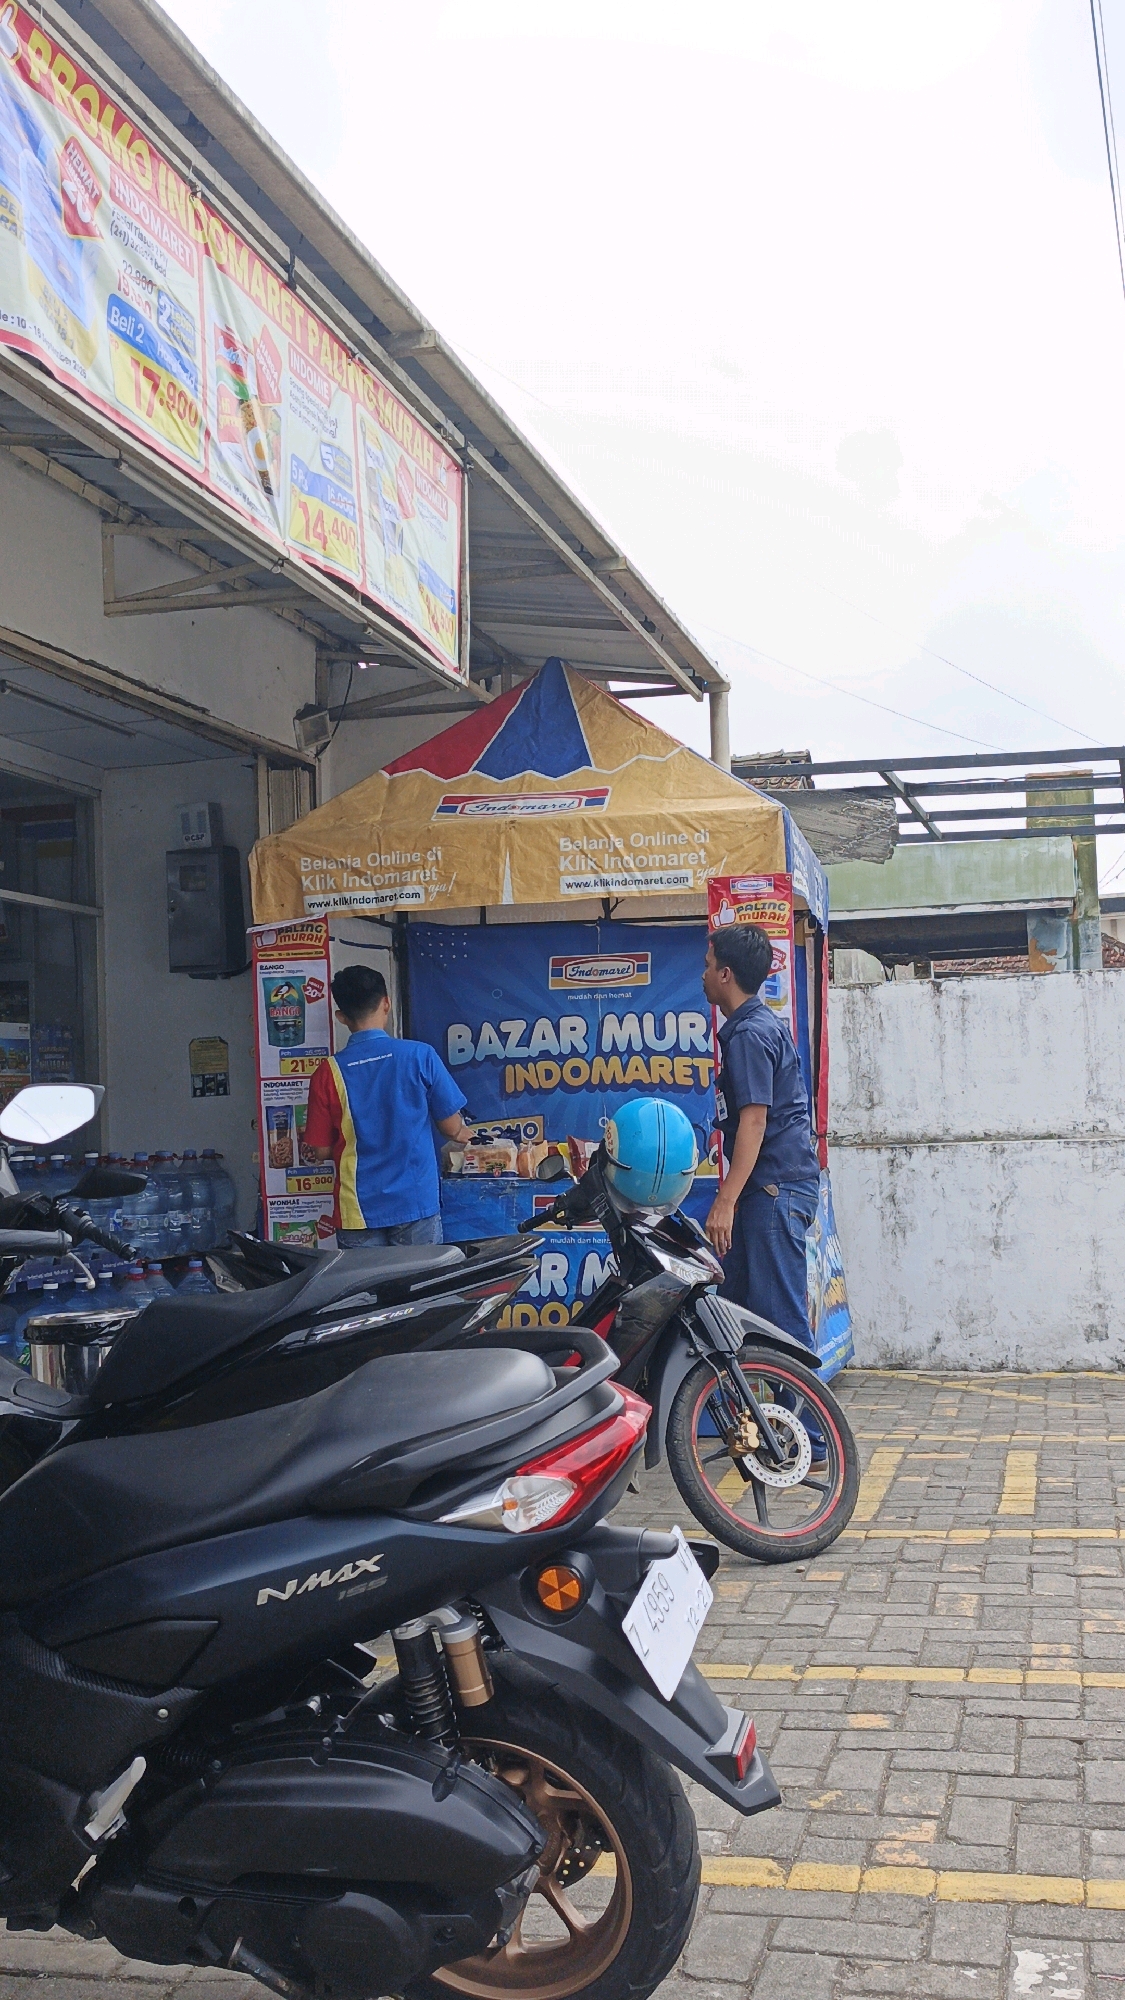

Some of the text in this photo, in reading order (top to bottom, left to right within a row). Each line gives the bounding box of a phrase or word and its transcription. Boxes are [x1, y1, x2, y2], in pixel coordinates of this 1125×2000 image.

[66, 143, 100, 198] HEMAT
[115, 175, 191, 269] INDOMARET
[27, 28, 154, 191] PROMO
[157, 160, 307, 345] INDOMARET
[307, 316, 377, 411] PALING
[377, 385, 434, 477] MURAH
[17, 316, 27, 329] 10
[109, 306, 145, 344] Beli 2
[290, 348, 330, 401] INDOMIE
[130, 356, 199, 428] 17.900
[298, 499, 356, 550] 14.400
[472, 798, 577, 813] Indomaret
[559, 828, 710, 852] Belanja Online di
[300, 846, 442, 872] Belanja Online di
[559, 854, 597, 872] Klik
[603, 850, 707, 870] Indomaret
[301, 867, 458, 901] Klik Indomaret aja!
[565, 874, 689, 889] www.klikindomaret.com
[307, 891, 421, 909] www.klikindomaret.com
[736, 902, 786, 914] PALING
[278, 923, 323, 935] PALING
[739, 910, 786, 921] MURAH
[280, 933, 323, 943] MURAH
[568, 965, 632, 978] Indomaret
[447, 1014, 589, 1066] BAZAR
[505, 1056, 714, 1093] INDOMARET
[311, 1313, 391, 1343] PCX
[257, 1553, 385, 1606] NMAX
[629, 1623, 649, 1658] Z
[642, 1572, 675, 1633] 4959
